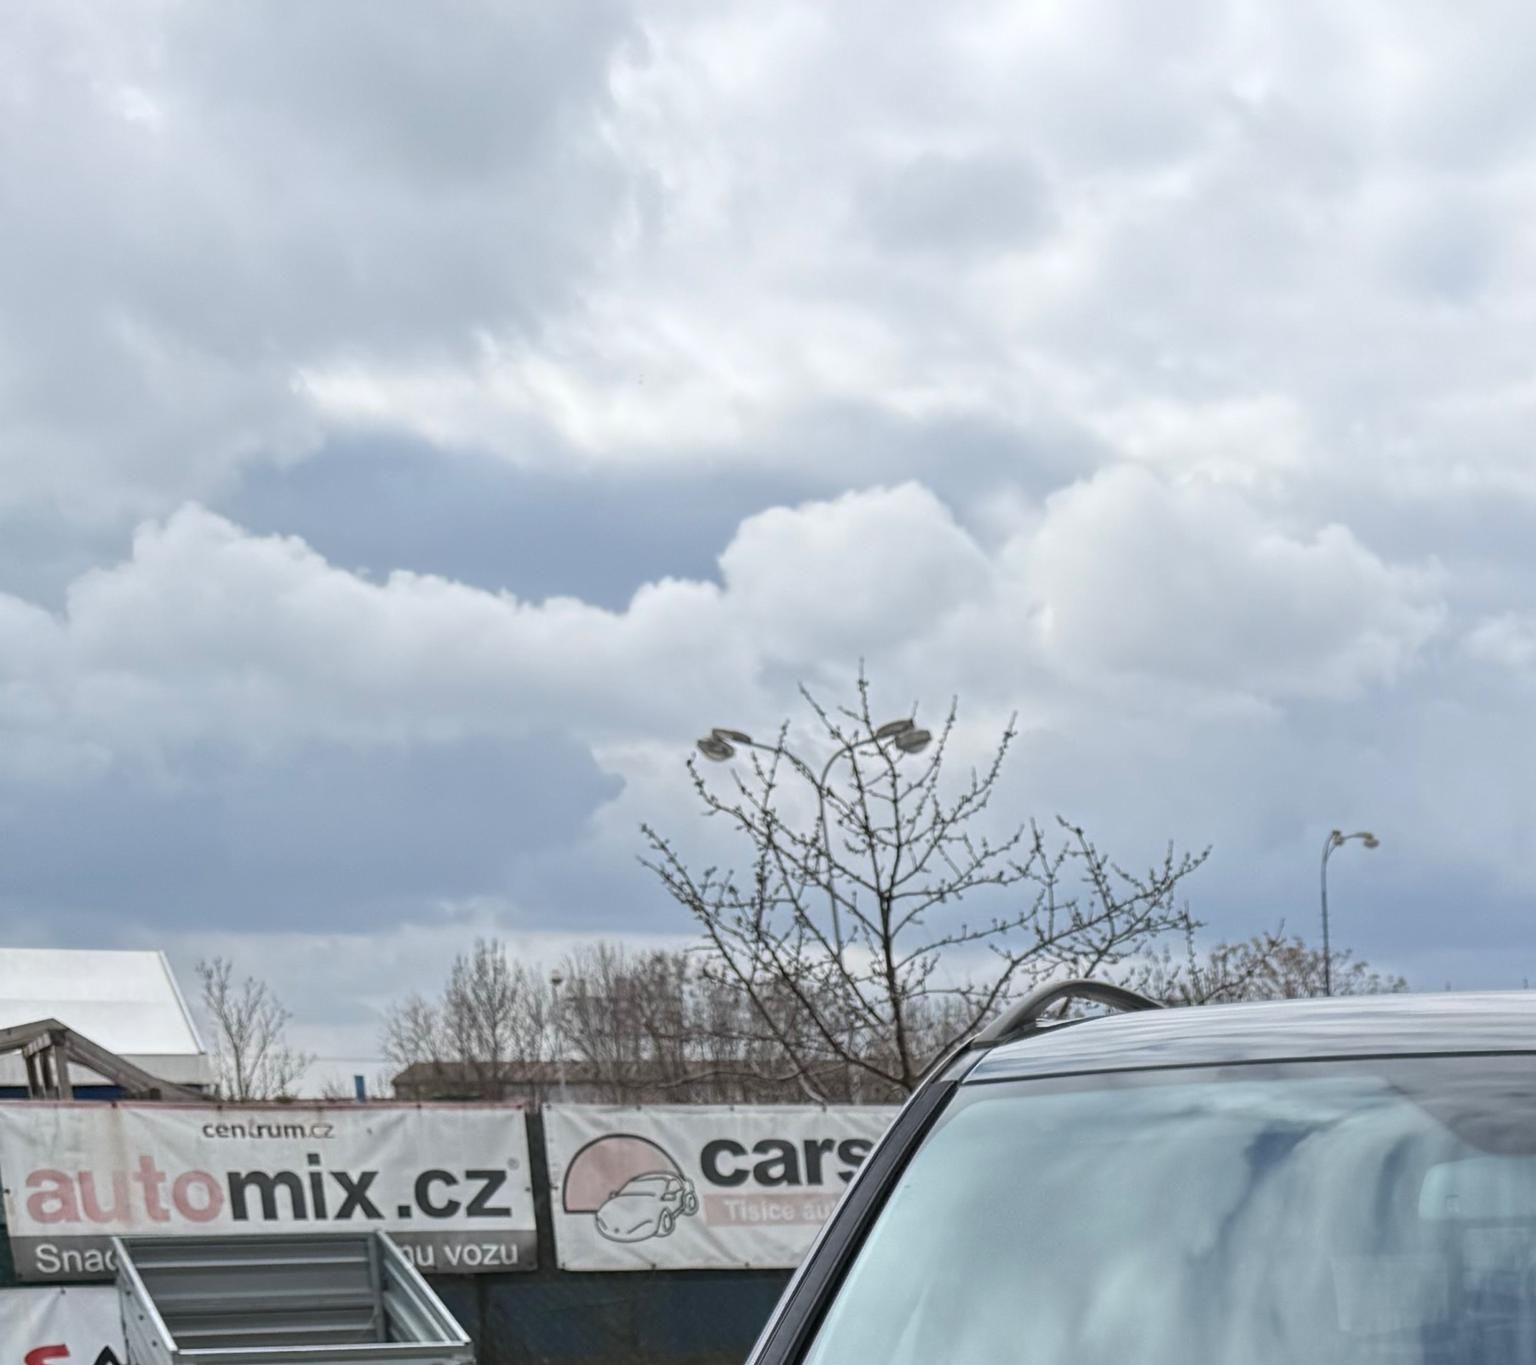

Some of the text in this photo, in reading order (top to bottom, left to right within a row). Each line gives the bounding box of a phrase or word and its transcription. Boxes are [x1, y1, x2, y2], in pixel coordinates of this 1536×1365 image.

[202, 1118, 336, 1140] centrum.cz
[25, 1153, 512, 1224] automix.cz
[443, 1242, 519, 1267] vozu
